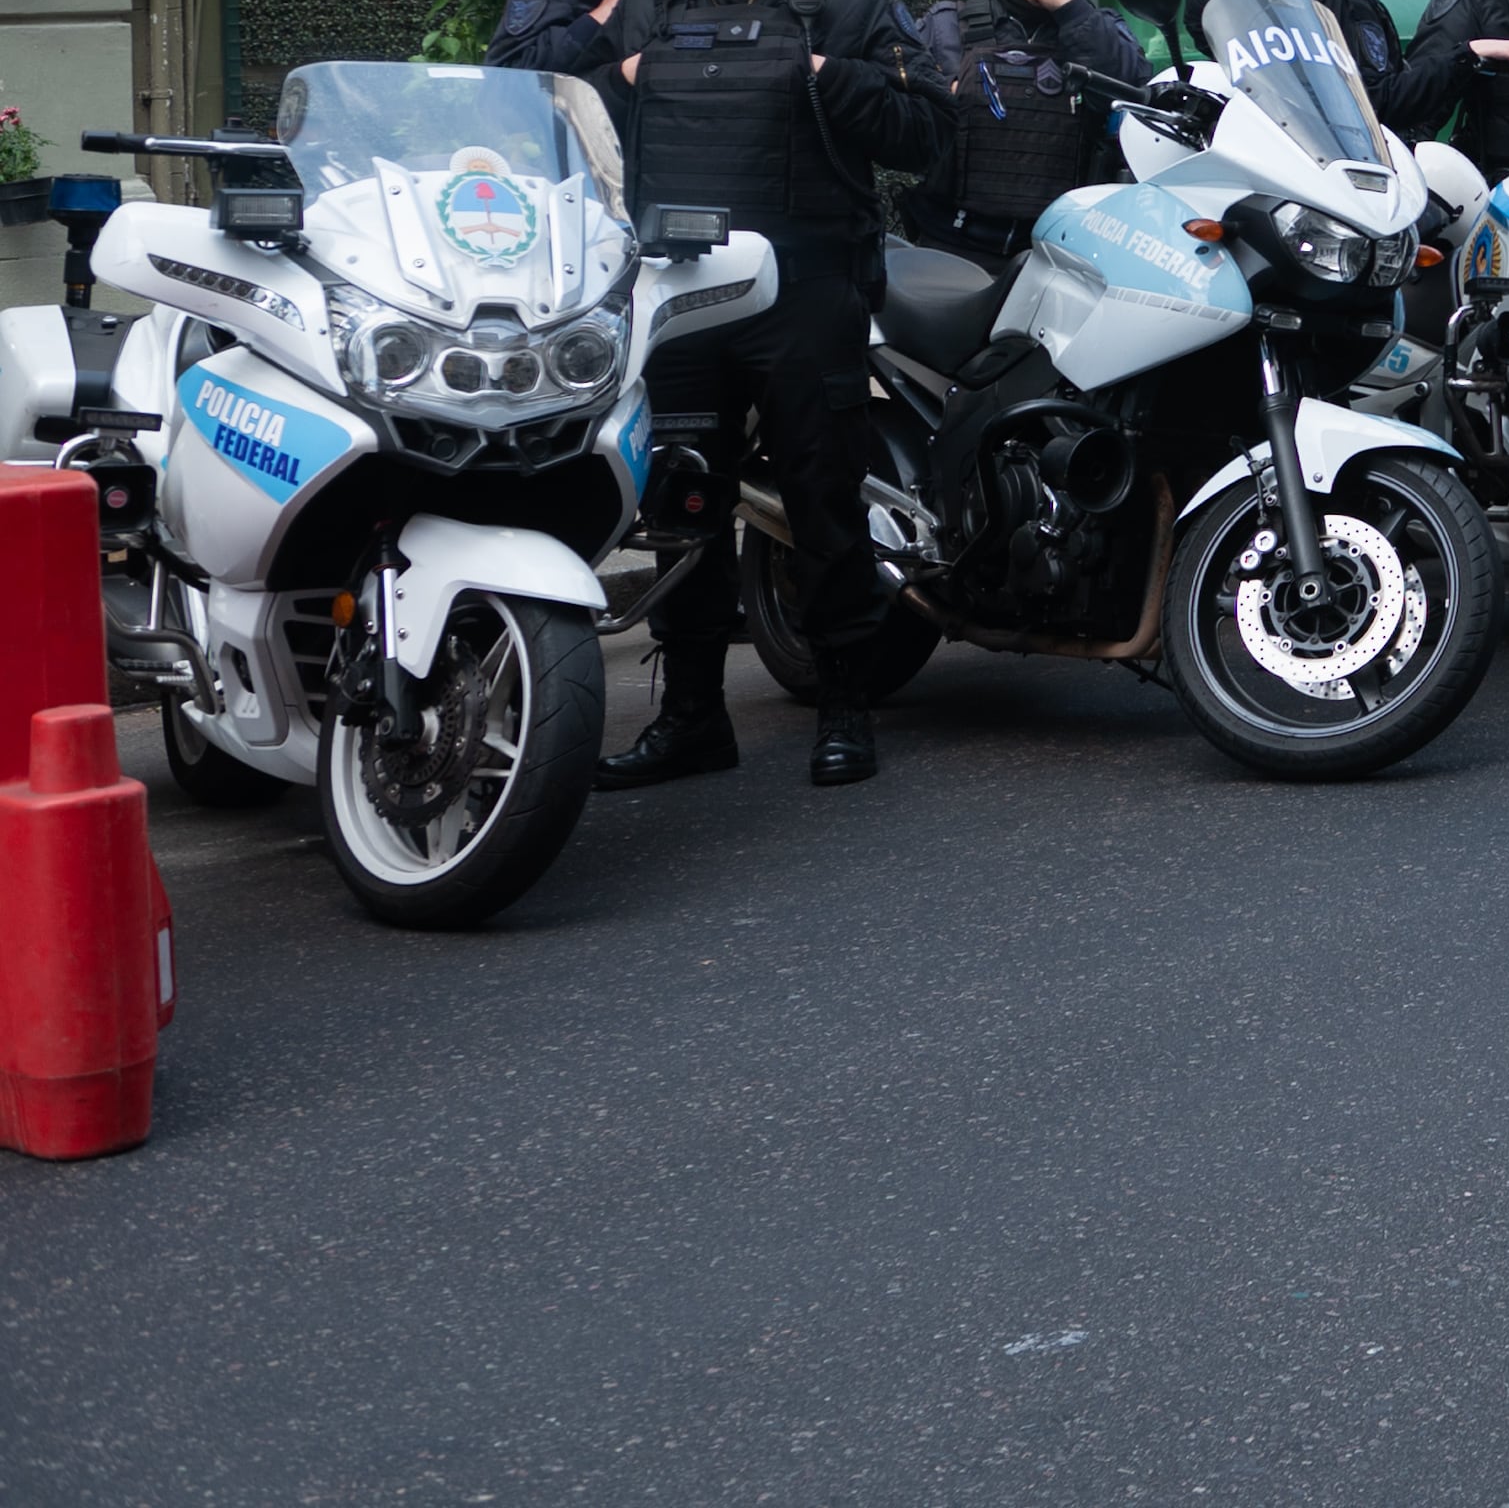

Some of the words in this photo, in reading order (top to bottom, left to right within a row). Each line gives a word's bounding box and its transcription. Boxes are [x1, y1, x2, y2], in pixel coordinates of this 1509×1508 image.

[1080, 208, 1130, 247] POLICIA
[1125, 229, 1210, 290] FEDERAL
[195, 379, 286, 448] POLICIA
[213, 423, 301, 487] FEDERAL
